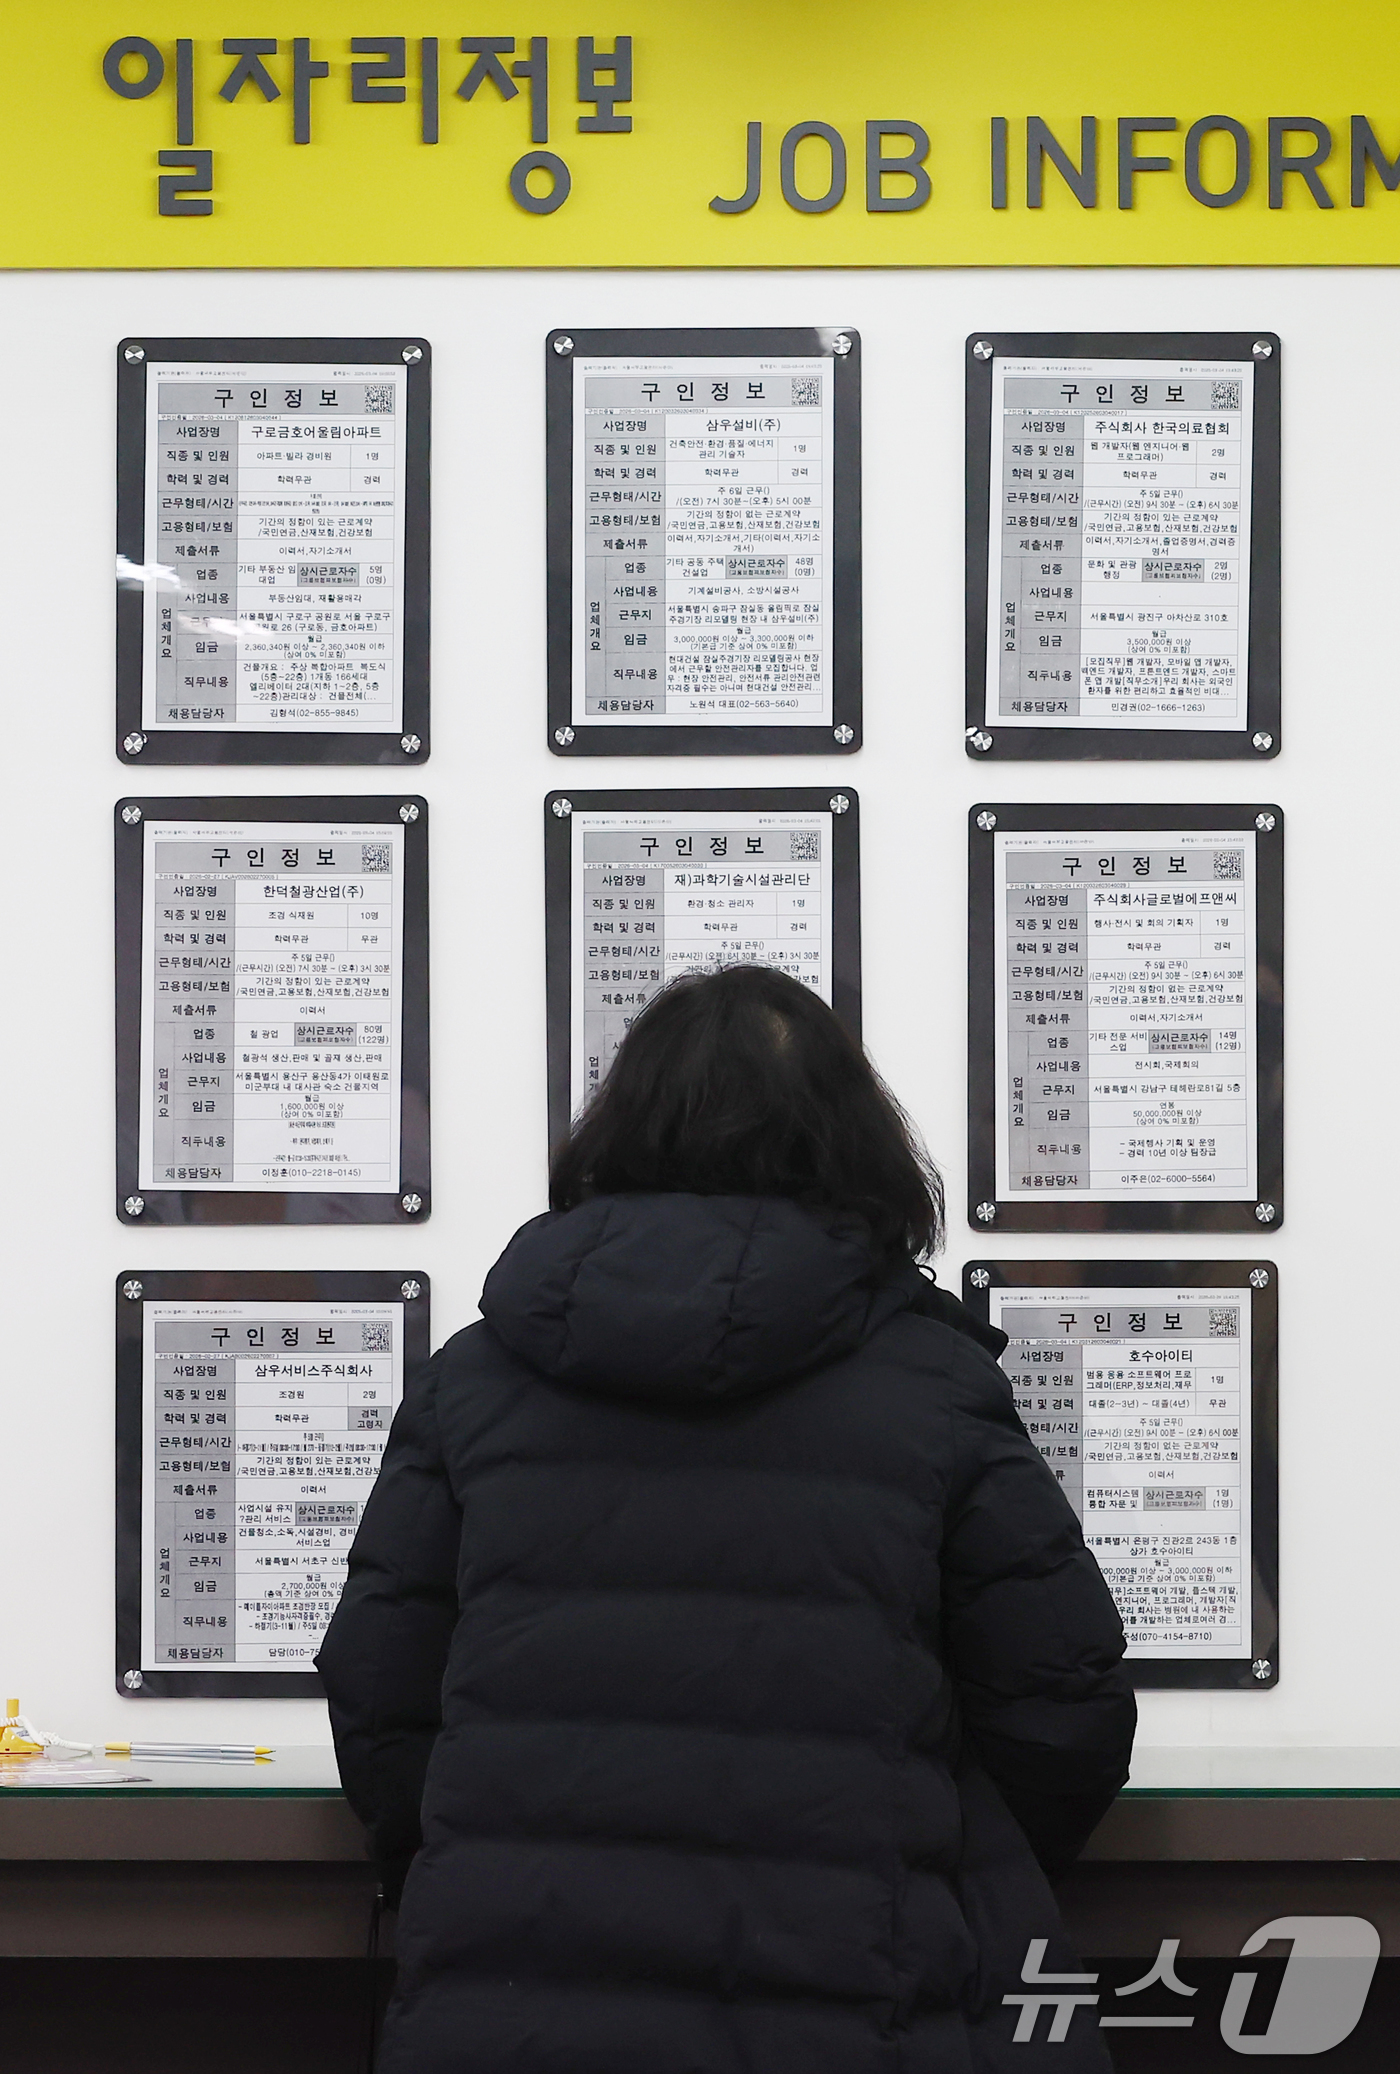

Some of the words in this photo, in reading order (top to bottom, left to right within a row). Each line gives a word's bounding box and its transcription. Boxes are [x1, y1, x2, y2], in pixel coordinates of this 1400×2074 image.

[102, 36, 632, 216] 일자리정보
[708, 120, 931, 214] JOB
[602, 419, 646, 432] 사업장명
[706, 418, 780, 431] 삼우설비(주)
[1021, 421, 1065, 432] 사업장명
[1095, 420, 1146, 434] 주식회사
[1152, 421, 1229, 435] 한국의료협회
[176, 426, 219, 437] 사업장명
[251, 425, 381, 438] 구로금호어울림아파트
[166, 450, 188, 461] 직종
[193, 450, 202, 461] 및
[207, 450, 229, 461] 인원
[306, 451, 331, 460] 경비원
[366, 451, 378, 460] 1명
[1011, 444, 1033, 456] 직종
[1038, 444, 1047, 456] 및
[1053, 444, 1074, 456] 인원
[704, 468, 738, 477] 학력무관
[791, 467, 808, 476] 경력
[1122, 470, 1157, 479] 학력무관
[1209, 471, 1226, 480] 경력
[166, 473, 187, 485] 학력
[192, 473, 202, 485] 및
[207, 473, 228, 485] 경력
[277, 475, 311, 484] 학력무관
[363, 475, 380, 484] 경력
[588, 490, 661, 502] 근무형태/시간
[1006, 492, 1079, 503] 근무형태/시간
[161, 497, 233, 509] 근무형태/시간
[258, 517, 284, 526] 기간의
[288, 517, 313, 526] 정함이
[317, 517, 335, 526] 있는
[337, 517, 372, 526] 근로계약
[589, 514, 660, 526] 고용형태/보험
[161, 521, 232, 532] 고용형태/보험
[603, 538, 647, 549] 제출서류
[1019, 539, 1063, 551] 제출서류
[174, 544, 220, 556] 제출서류
[278, 546, 351, 555] 이력서,자기소개서
[624, 562, 646, 573] 업종
[1040, 563, 1062, 574] 업종
[196, 568, 218, 580] 업종
[613, 585, 657, 597] 사업내용
[1029, 586, 1073, 598] 사업내용
[184, 592, 229, 604] 사업내용
[618, 609, 651, 620] 근무지
[1034, 610, 1066, 622] 근무지
[1090, 612, 1133, 621] 서울특별시
[1137, 612, 1162, 622] 광진구
[623, 633, 647, 645] 임금
[1038, 634, 1062, 647] 임금
[195, 641, 218, 653] 임금
[1011, 700, 1067, 712] 채용담당자
[167, 707, 224, 719] 채용담당자
[601, 874, 645, 886] 사업장명
[674, 872, 810, 886] 재)과학기술시설관리단
[173, 885, 216, 897] 사업장명
[263, 885, 363, 898] 한덕철광산업(주)
[592, 898, 614, 910] 직종
[618, 898, 628, 909] 및
[633, 898, 654, 909] 인원
[728, 899, 754, 908] 관리자
[1024, 894, 1068, 906] 사업장명
[1093, 892, 1236, 906] 주식회사글로벌에프앤씨
[268, 911, 285, 919] 조경
[288, 911, 314, 920] 식재원
[360, 911, 378, 920] 10명
[703, 922, 737, 931] 학력무관
[1015, 918, 1037, 930] 직종
[1041, 918, 1051, 930] 및
[1056, 918, 1077, 929] 인원
[274, 934, 308, 943] 학력무관
[360, 934, 378, 943] 무관
[587, 945, 660, 957] 근무형태/시간
[1016, 942, 1036, 954] 학력
[1042, 942, 1051, 953] 및
[1056, 942, 1078, 953] 경력
[1126, 942, 1161, 951] 학력무관
[158, 956, 231, 968] 근무형태/시간
[588, 969, 659, 981] 고용형태/보험
[1011, 965, 1083, 977] 근무형태/시간
[158, 980, 229, 992] 고용형태/보험
[299, 1006, 325, 1014] 이력서
[1025, 1013, 1070, 1025] 제출서류
[1129, 1012, 1202, 1022] 이력서,자기소개서
[1046, 1036, 1068, 1048] 업종
[181, 1051, 226, 1063] 사업내용
[186, 1075, 219, 1087] 근무지
[1042, 1084, 1074, 1095] 근무지
[1093, 1084, 1136, 1093] 서울특별시
[1140, 1084, 1166, 1093] 강남구
[192, 1100, 215, 1112] 임금
[1047, 1108, 1070, 1120] 임금
[1019, 1350, 1063, 1362] 사업장명
[1128, 1349, 1192, 1362] 호수아이티
[173, 1365, 216, 1376] 사업장명
[254, 1363, 372, 1377] 삼우서비스주식회사
[1127, 1369, 1170, 1379] 소프트웨어
[1010, 1374, 1033, 1387] 직종
[1037, 1374, 1046, 1386] 및
[1052, 1374, 1073, 1386] 인원
[1211, 1375, 1223, 1384] 1명
[278, 1390, 304, 1399] 조경원
[362, 1390, 376, 1399] 2명
[1208, 1398, 1226, 1407] 무관
[163, 1412, 184, 1424] 학력
[190, 1412, 199, 1424] 및
[204, 1412, 226, 1424] 경력
[159, 1436, 231, 1448] 근무형태/시간
[158, 1460, 230, 1472] 고용형태/보험
[182, 1531, 228, 1543] 사업내용
[254, 1556, 298, 1566] 서울특별시
[301, 1556, 327, 1565] 서초구
[167, 1647, 223, 1659] 채용담당자
